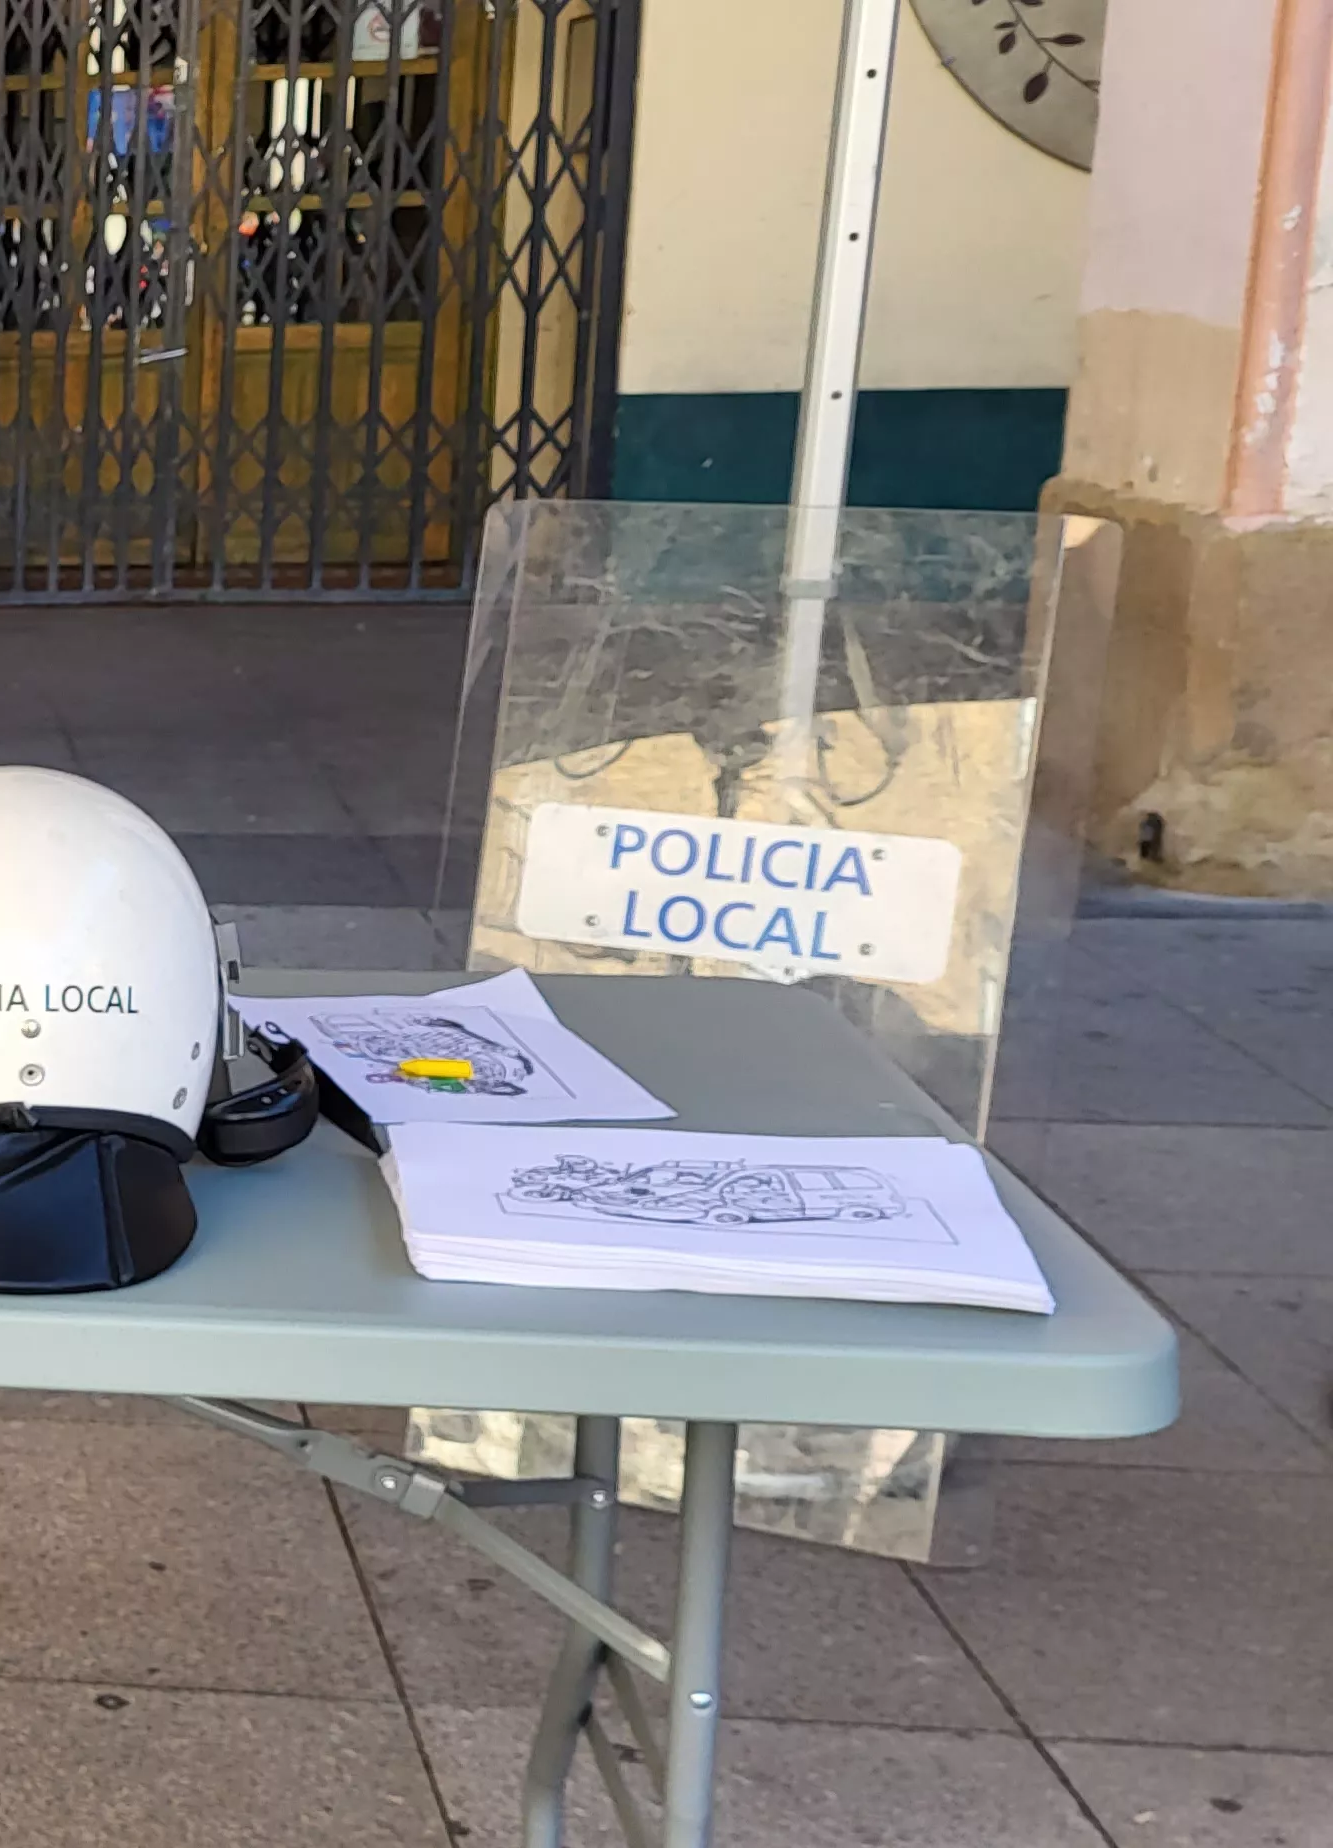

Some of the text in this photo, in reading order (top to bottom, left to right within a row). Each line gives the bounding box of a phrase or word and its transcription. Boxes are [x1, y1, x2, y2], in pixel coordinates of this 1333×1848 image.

[609, 823, 873, 896] POLICIA
[622, 890, 842, 961] LOCAL
[44, 983, 140, 1014] LOCAL
